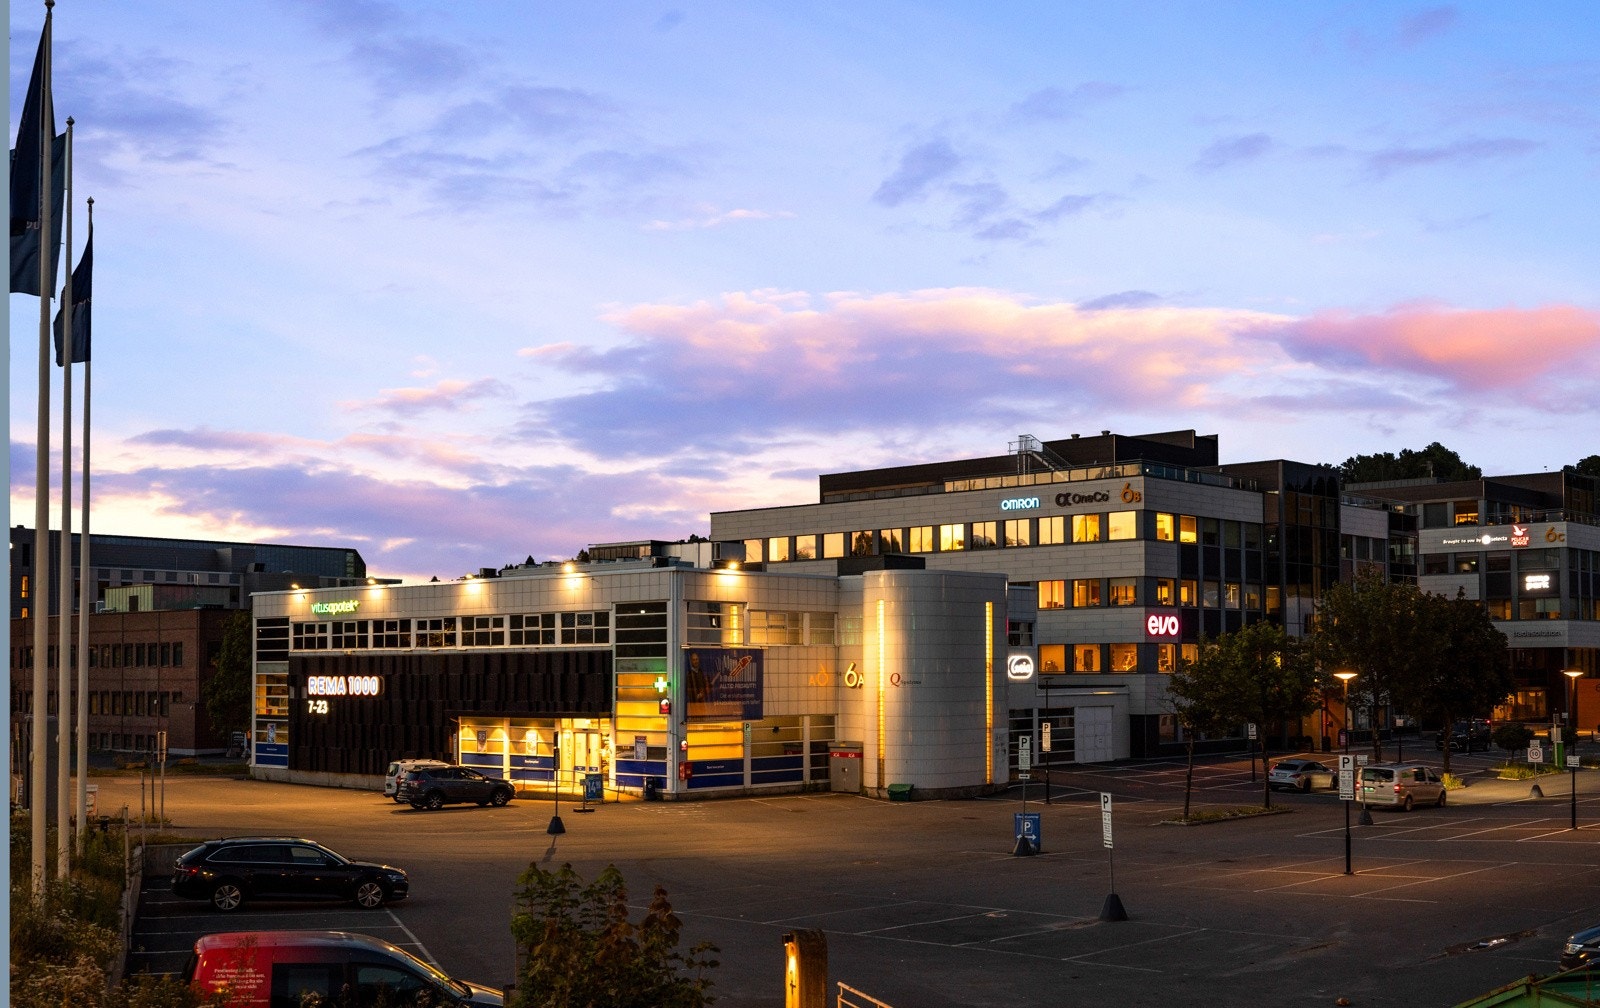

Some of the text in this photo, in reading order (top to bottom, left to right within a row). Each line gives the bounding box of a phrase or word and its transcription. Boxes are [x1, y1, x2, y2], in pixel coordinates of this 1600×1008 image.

[1001, 497, 1040, 511] OMRON
[1147, 614, 1179, 636] evo
[308, 675, 380, 696] REMA 1000
[308, 700, 329, 714] 7-23
[1021, 737, 1028, 748] P
[1342, 757, 1350, 768] P
[1103, 795, 1109, 809] P
